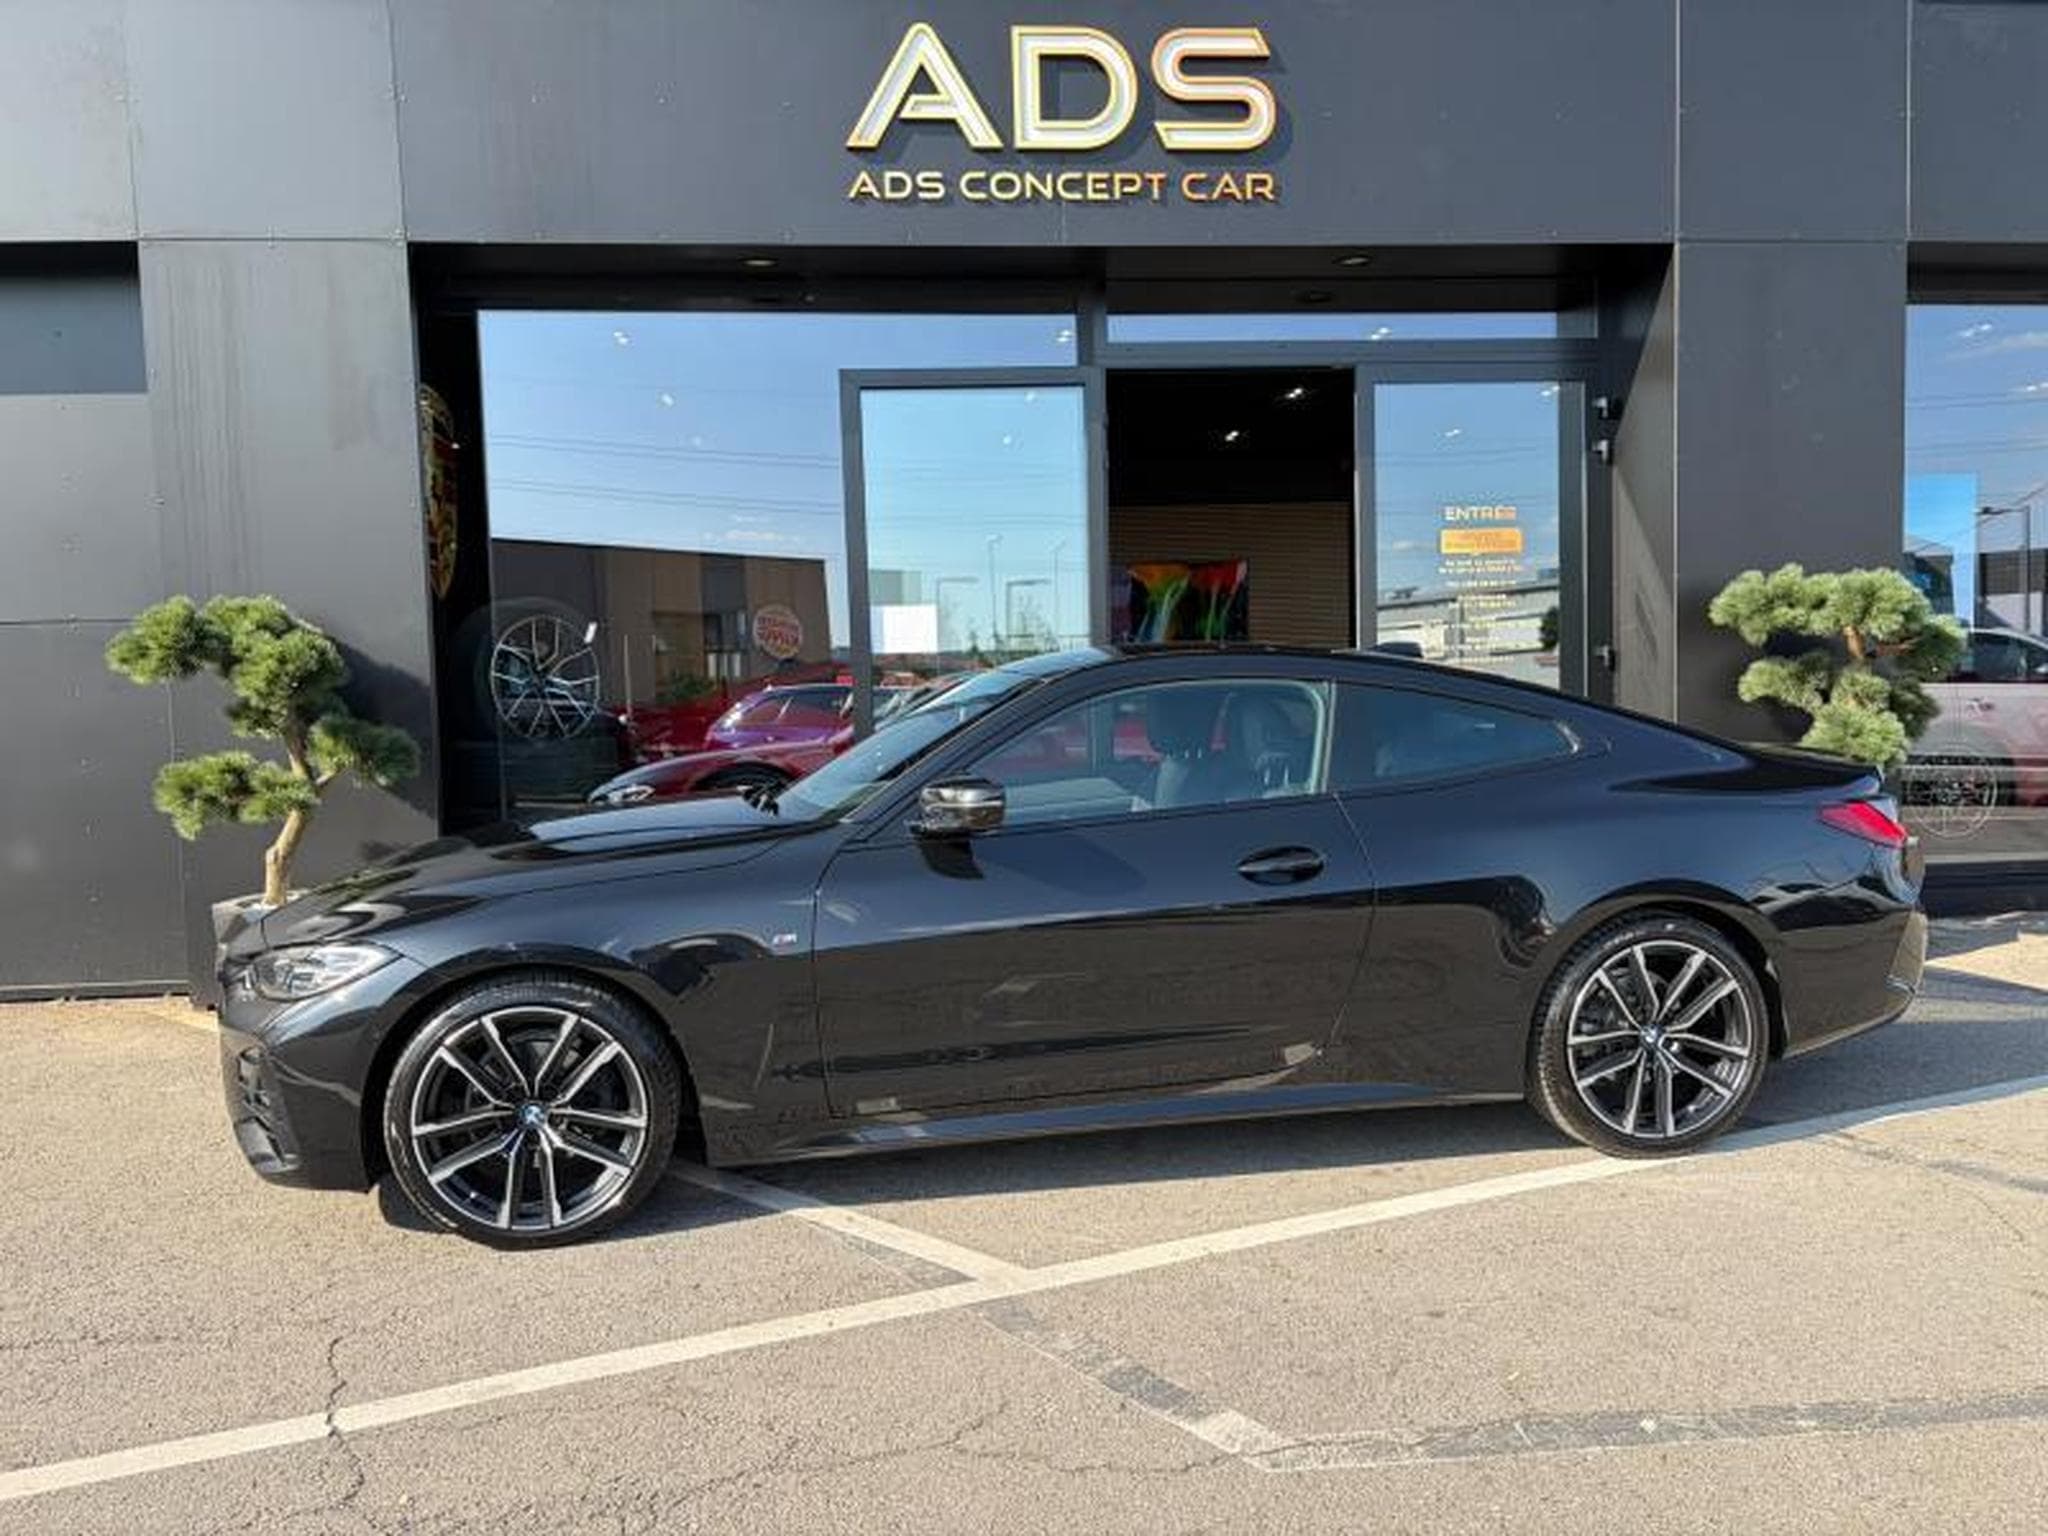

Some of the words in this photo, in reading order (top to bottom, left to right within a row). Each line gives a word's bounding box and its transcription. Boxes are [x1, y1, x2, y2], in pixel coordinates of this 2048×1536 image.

[846, 22, 1277, 150] ADS
[848, 171, 946, 200] ADS
[959, 171, 1166, 201] CONCEPT
[1182, 171, 1275, 201] CAR
